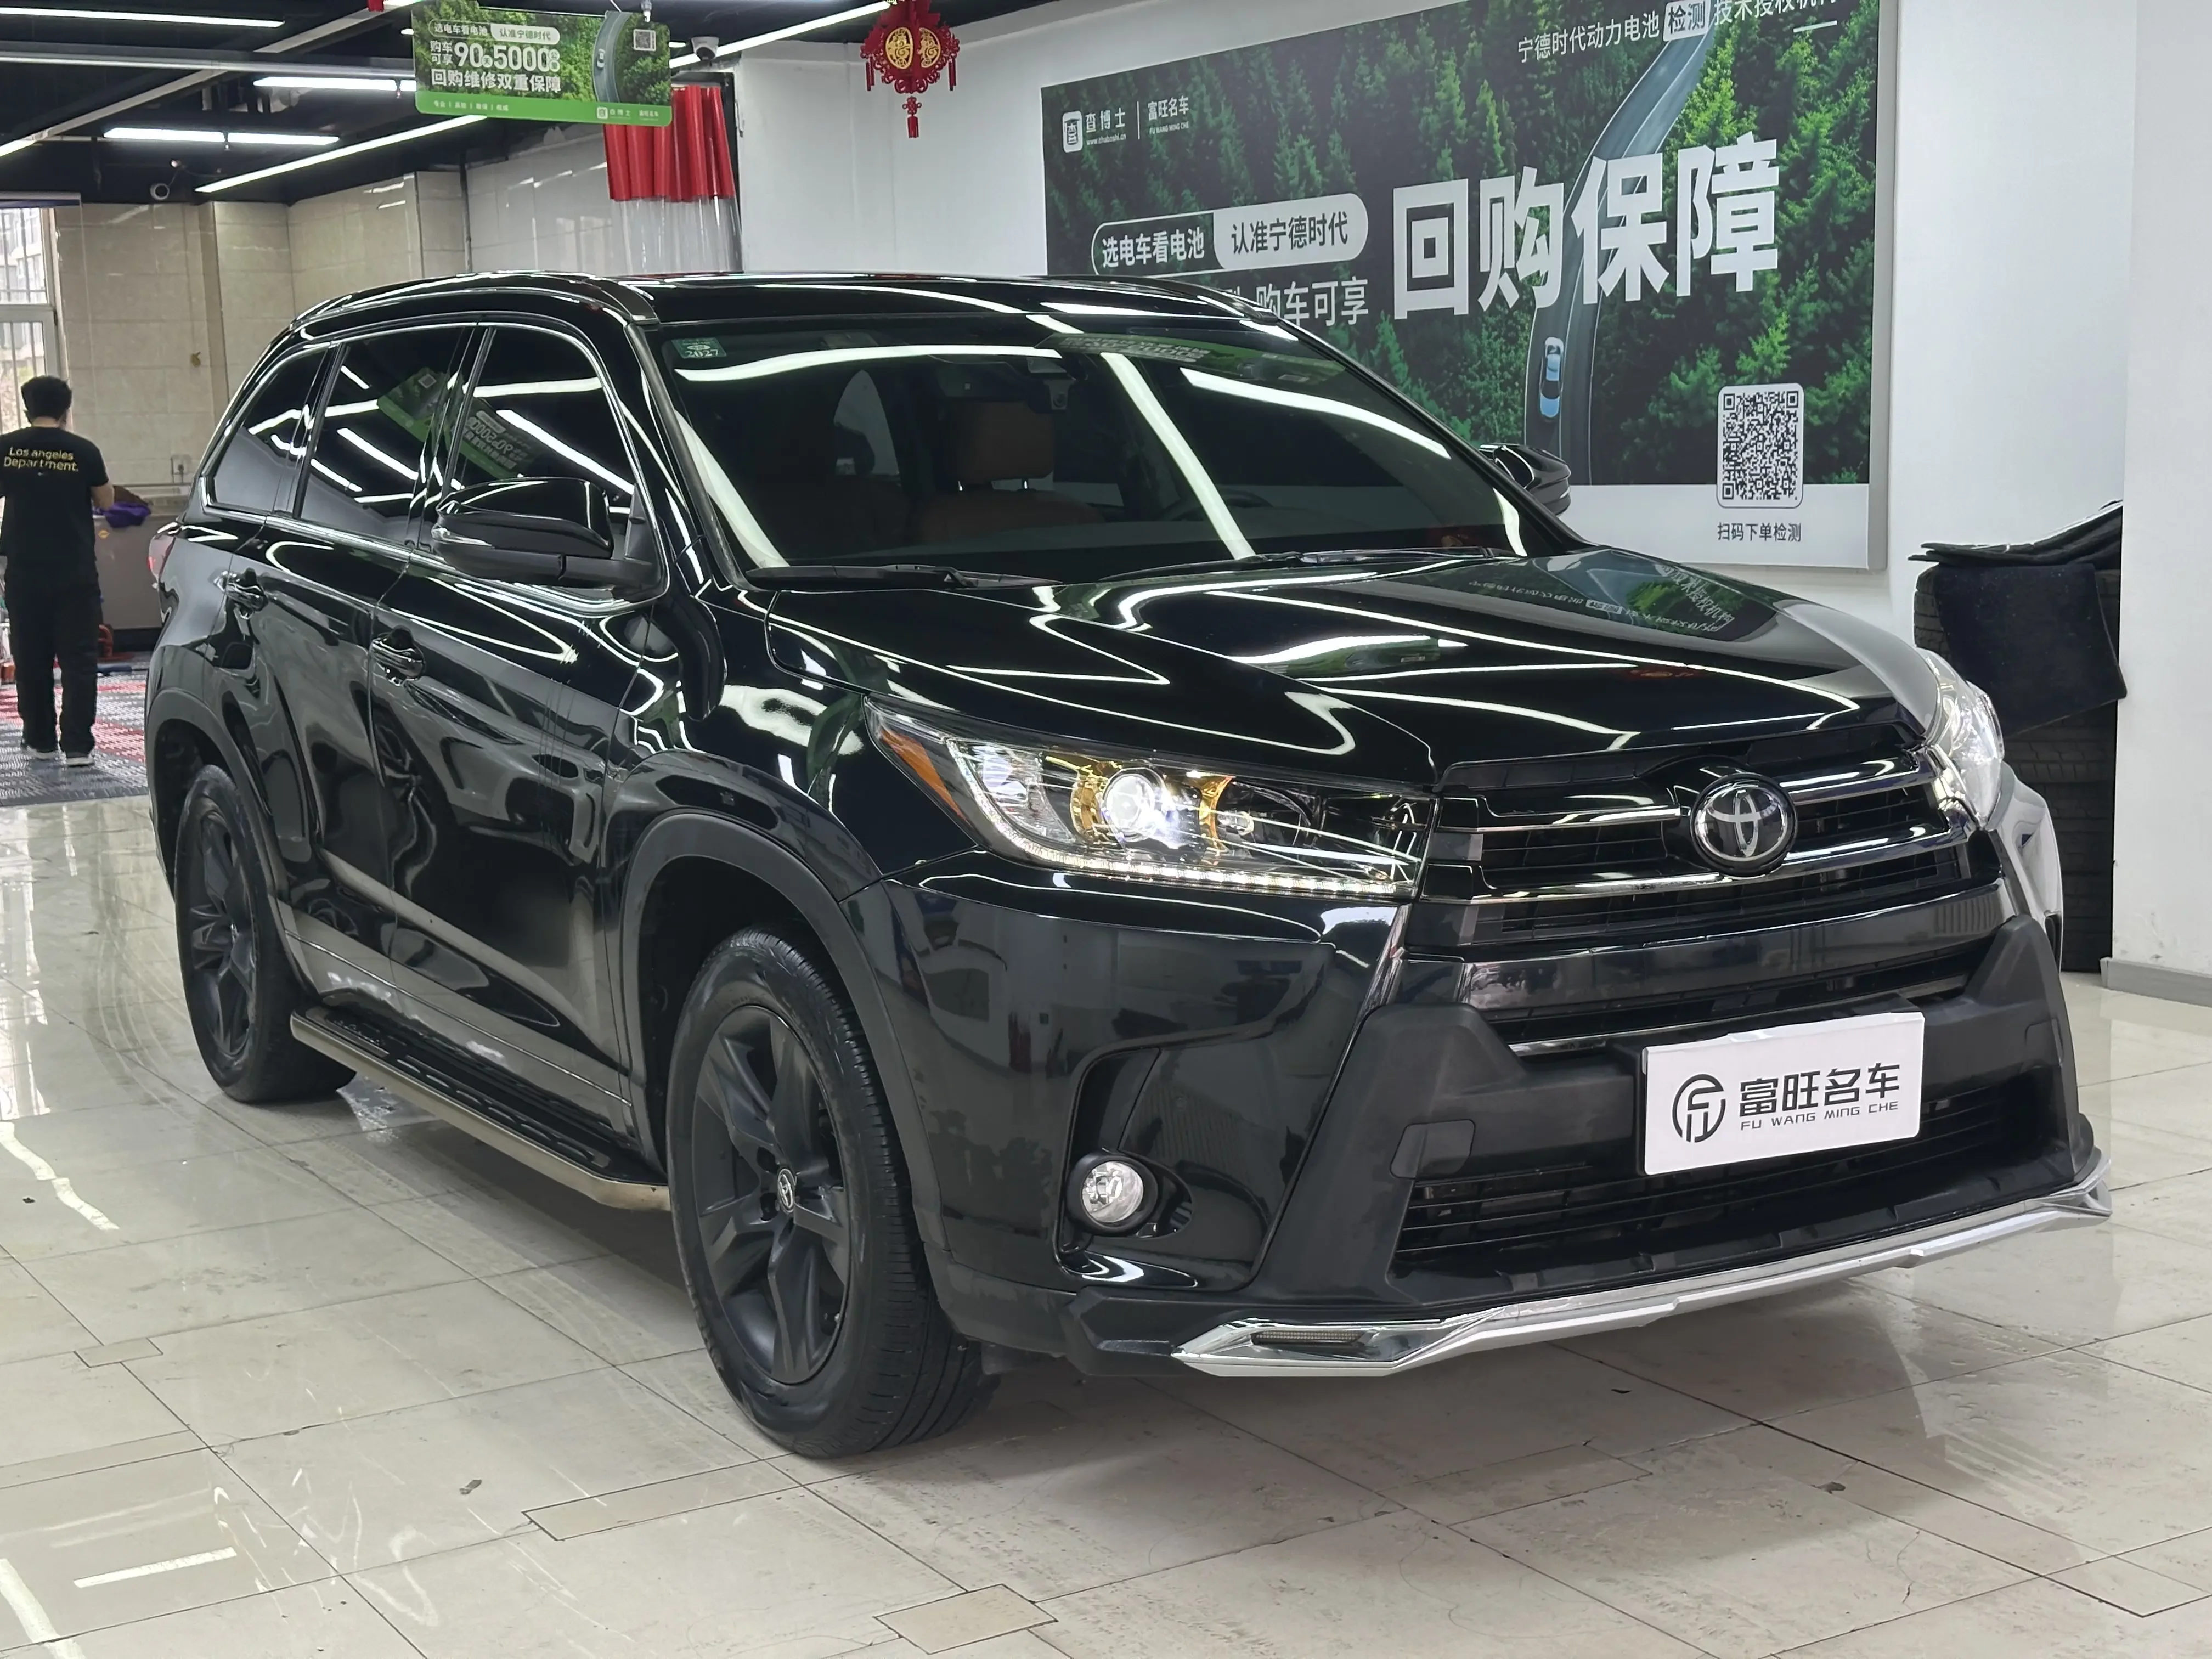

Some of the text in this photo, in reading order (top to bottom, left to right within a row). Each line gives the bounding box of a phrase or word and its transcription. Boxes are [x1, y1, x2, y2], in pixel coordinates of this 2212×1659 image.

[435, 22, 551, 41] 选电车看电池 认准宁德时代
[1517, 0, 1837, 63] 宁德时代动力电池 检测 技术授权
[431, 41, 452, 52] 购车
[454, 42, 483, 67] 90
[483, 55, 493, 67] 天
[494, 44, 549, 72] 5000
[431, 53, 453, 65] 可享
[431, 69, 561, 93] 回购维修双重保障
[1085, 108, 1126, 133] 查博士
[1148, 95, 1189, 121] 富旺名车
[1393, 131, 1779, 319] 回购保障
[1102, 211, 1348, 268] 选电车看电池 认准宁德时代
[1256, 275, 1369, 327] 购车可享
[685, 349, 718, 357] 2027
[9, 446, 74, 460] Los angeles
[1717, 522, 1802, 543] 扫码下单检测
[1739, 1062, 1901, 1117] 富旺名车
[1741, 1101, 1899, 1131] FU WANG MING CHE
